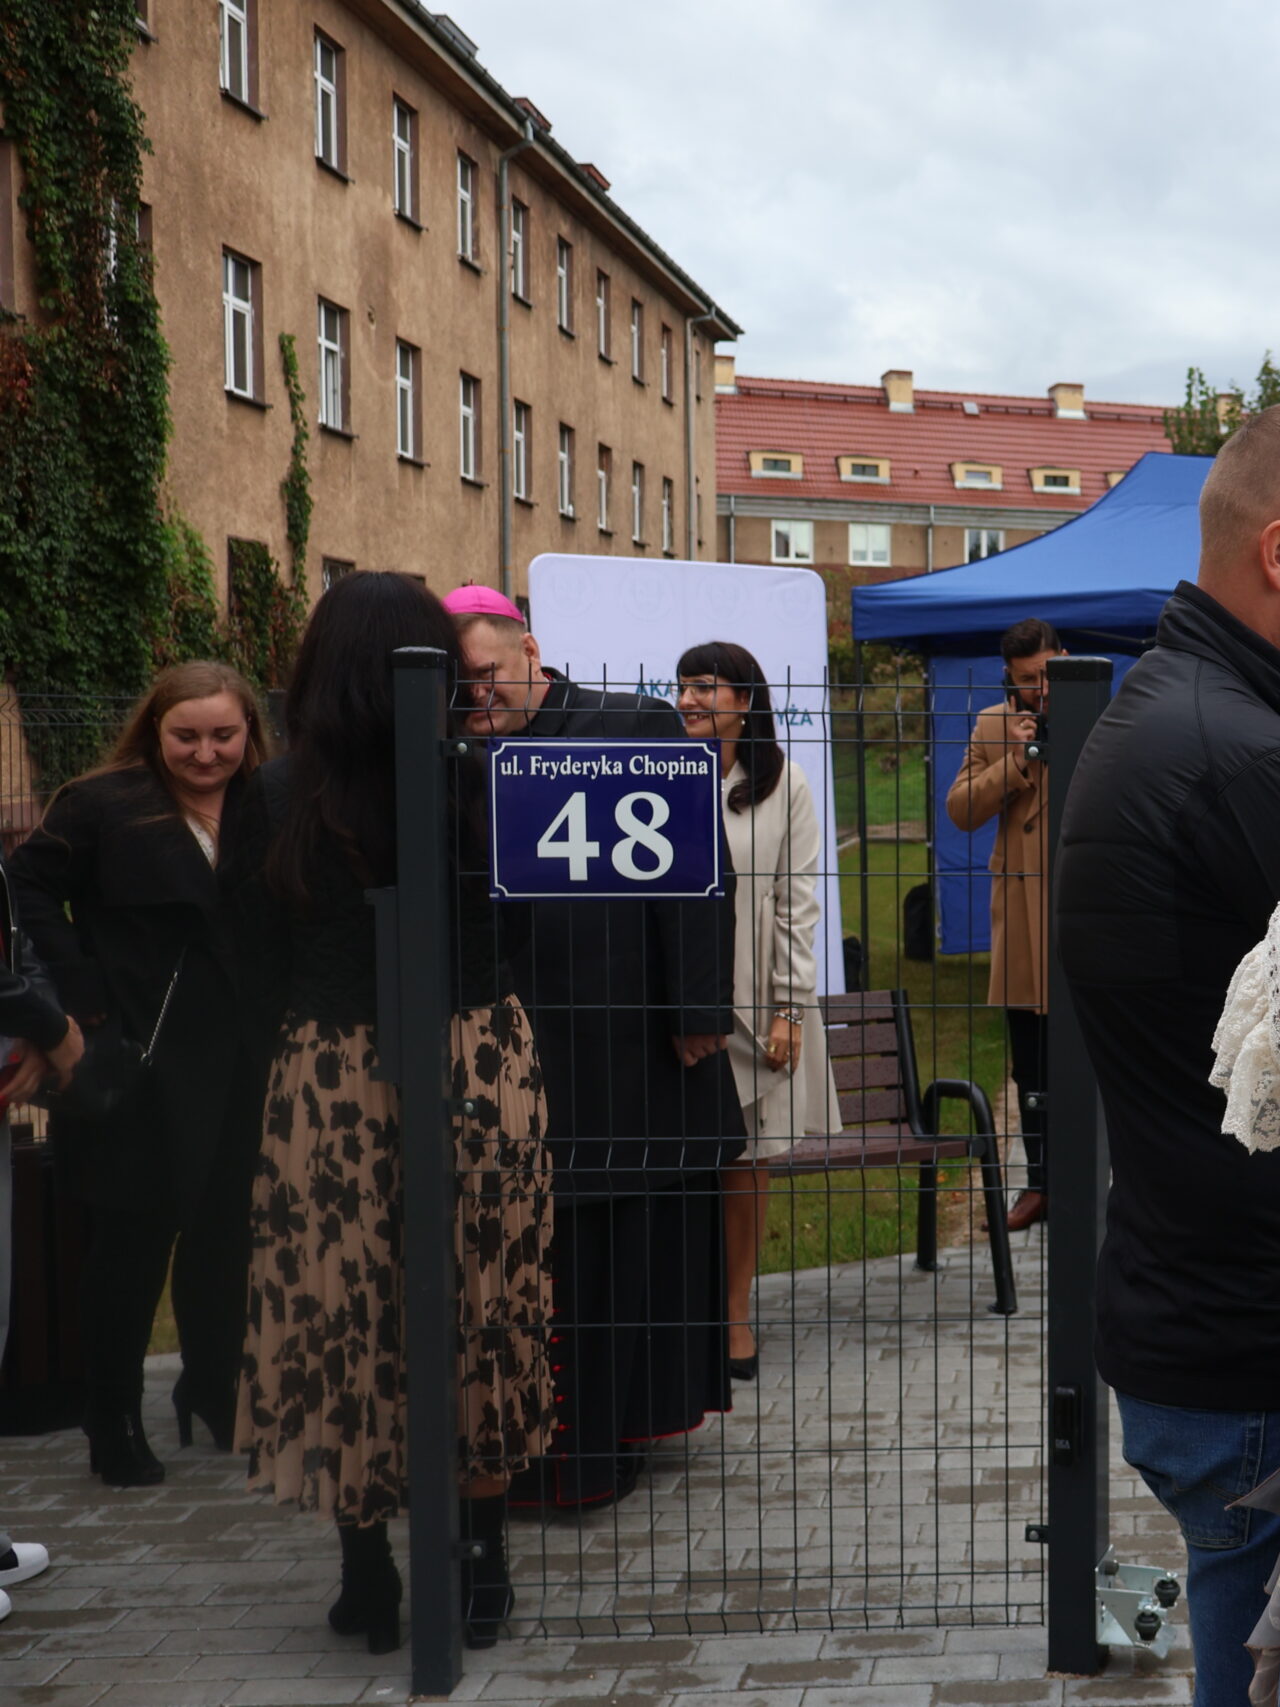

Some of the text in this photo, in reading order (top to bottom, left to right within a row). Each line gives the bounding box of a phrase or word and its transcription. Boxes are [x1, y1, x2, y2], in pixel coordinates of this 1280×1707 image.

[775, 704, 813, 726] YŻA
[501, 755, 709, 781] ul. Fryderyka Chopina
[537, 791, 674, 881] 48
